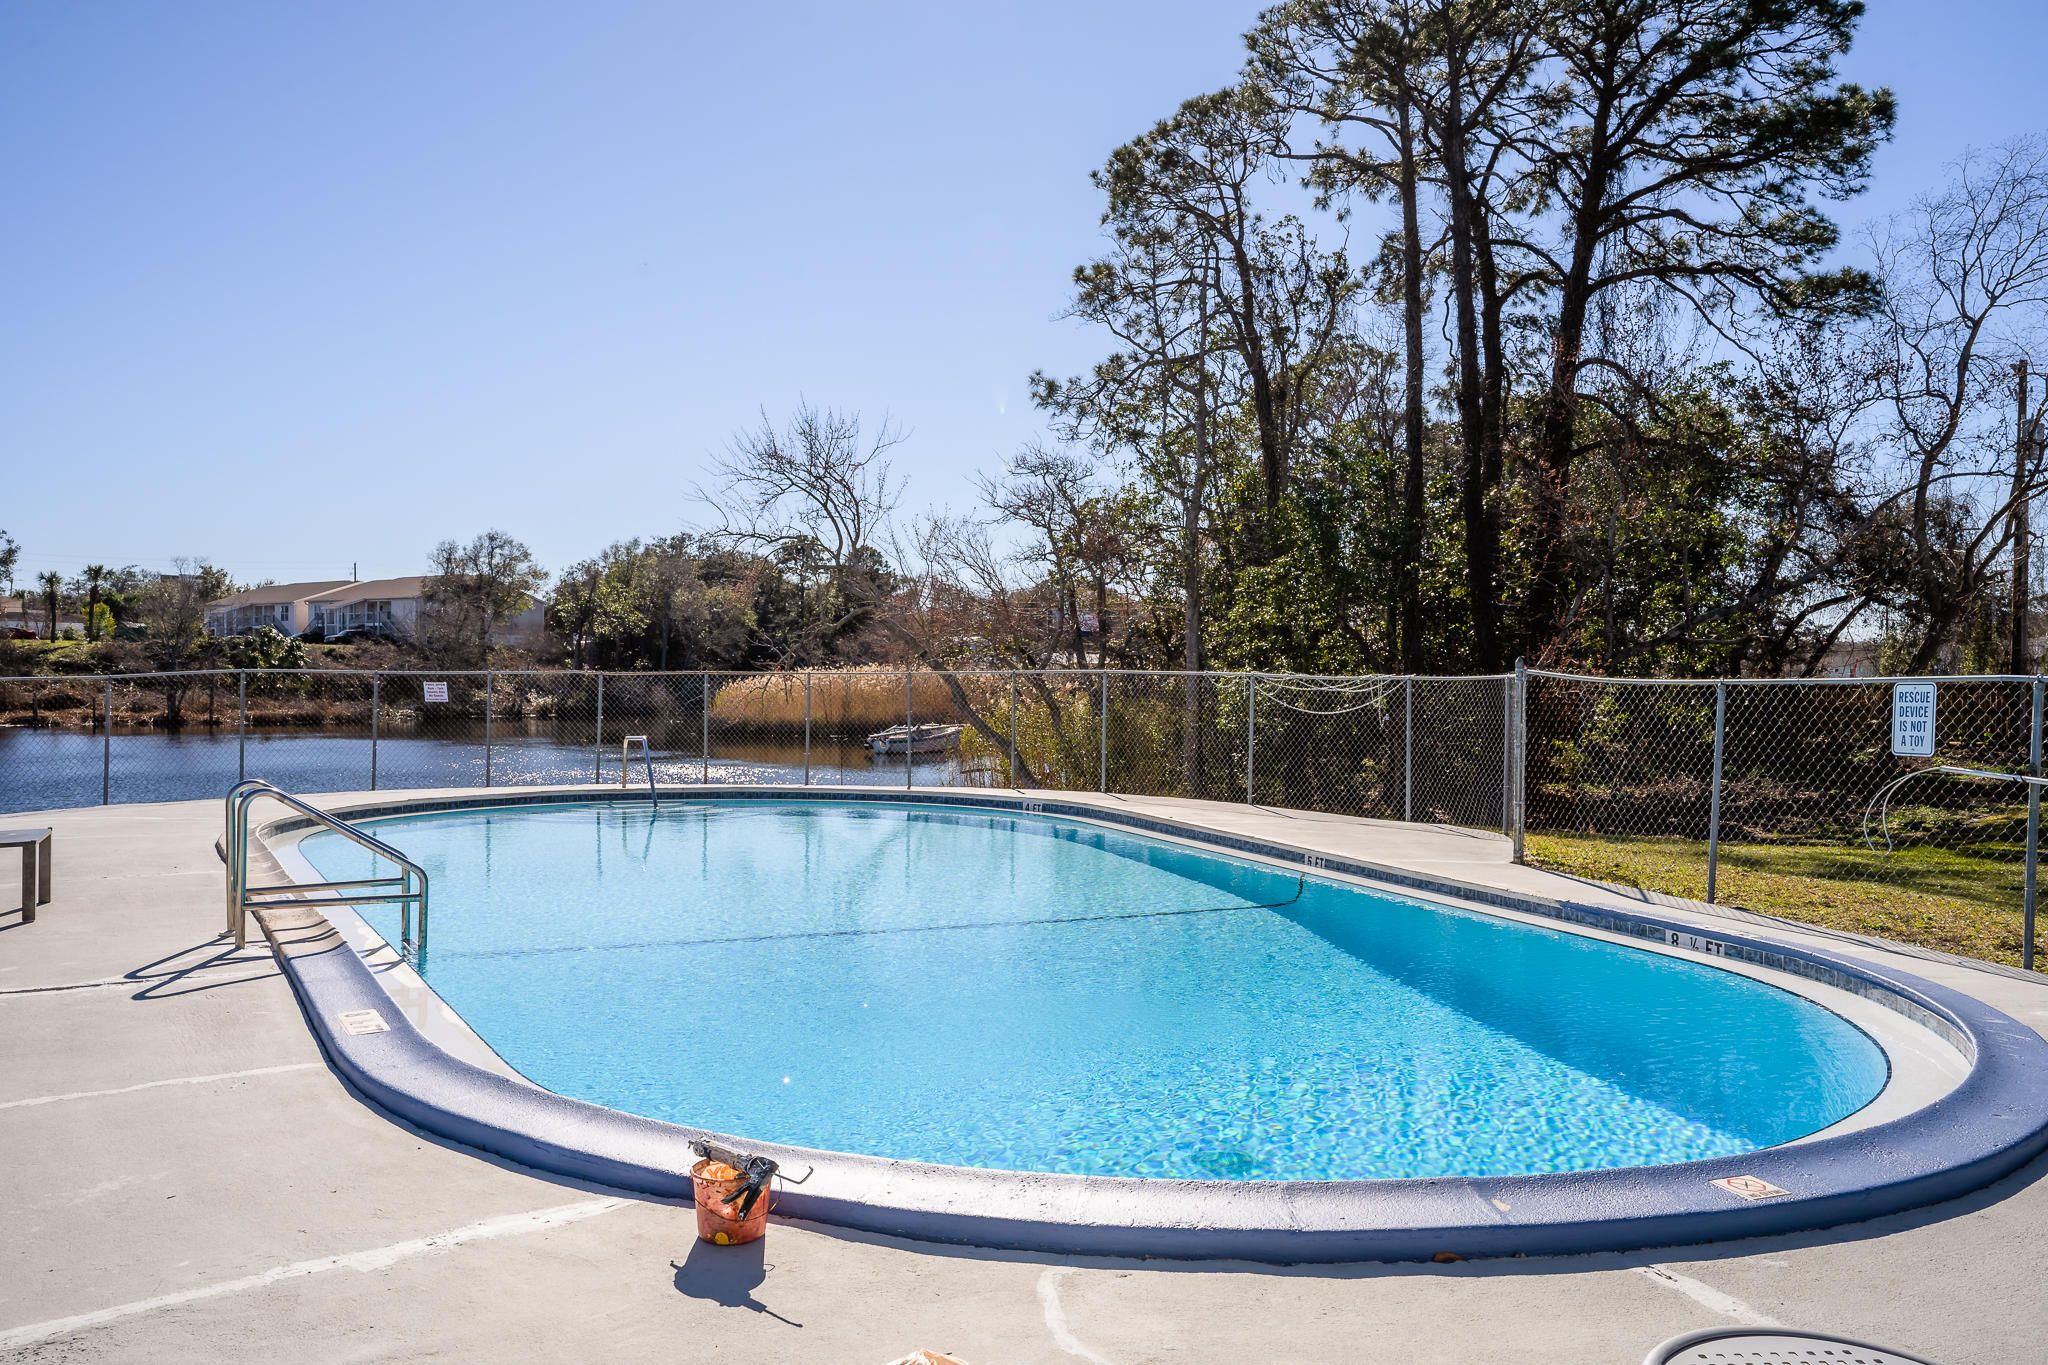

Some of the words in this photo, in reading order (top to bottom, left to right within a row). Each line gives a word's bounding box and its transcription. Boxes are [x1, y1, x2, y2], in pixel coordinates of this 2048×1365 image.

[1898, 691, 1931, 703] RESCUE
[1899, 706, 1929, 718] DEVICE
[1899, 720, 1908, 732] IS
[1910, 721, 1928, 733] NOT
[1900, 735, 1907, 747] A
[1909, 735, 1925, 747] TOY
[1025, 803, 1030, 811] 4
[1032, 803, 1041, 812] FT
[1307, 855, 1313, 866] 5
[1315, 856, 1325, 868] FT
[1671, 932, 1679, 946] 8
[1705, 939, 1723, 955] FT
